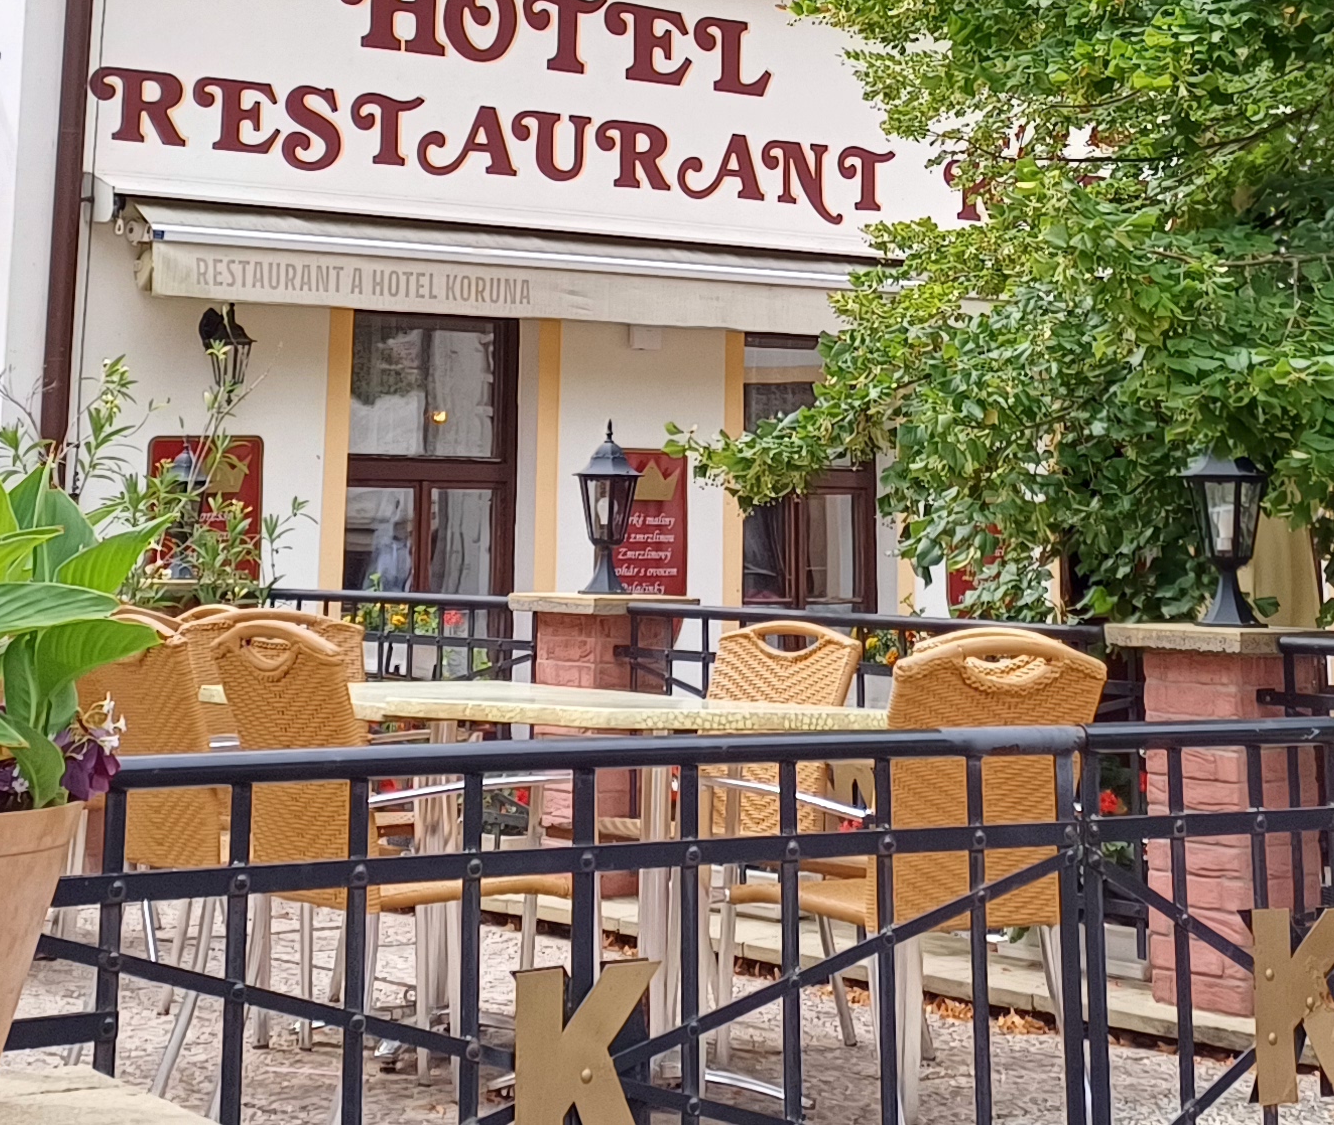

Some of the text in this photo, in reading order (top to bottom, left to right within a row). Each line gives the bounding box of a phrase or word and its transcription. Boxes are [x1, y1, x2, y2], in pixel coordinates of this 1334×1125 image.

[89, 65, 896, 225] RESTAURANT
[195, 257, 532, 306] RESTAURANT A HOTEL KORUNA
[614, 563, 638, 576] ohár
[514, 961, 662, 1125] K
